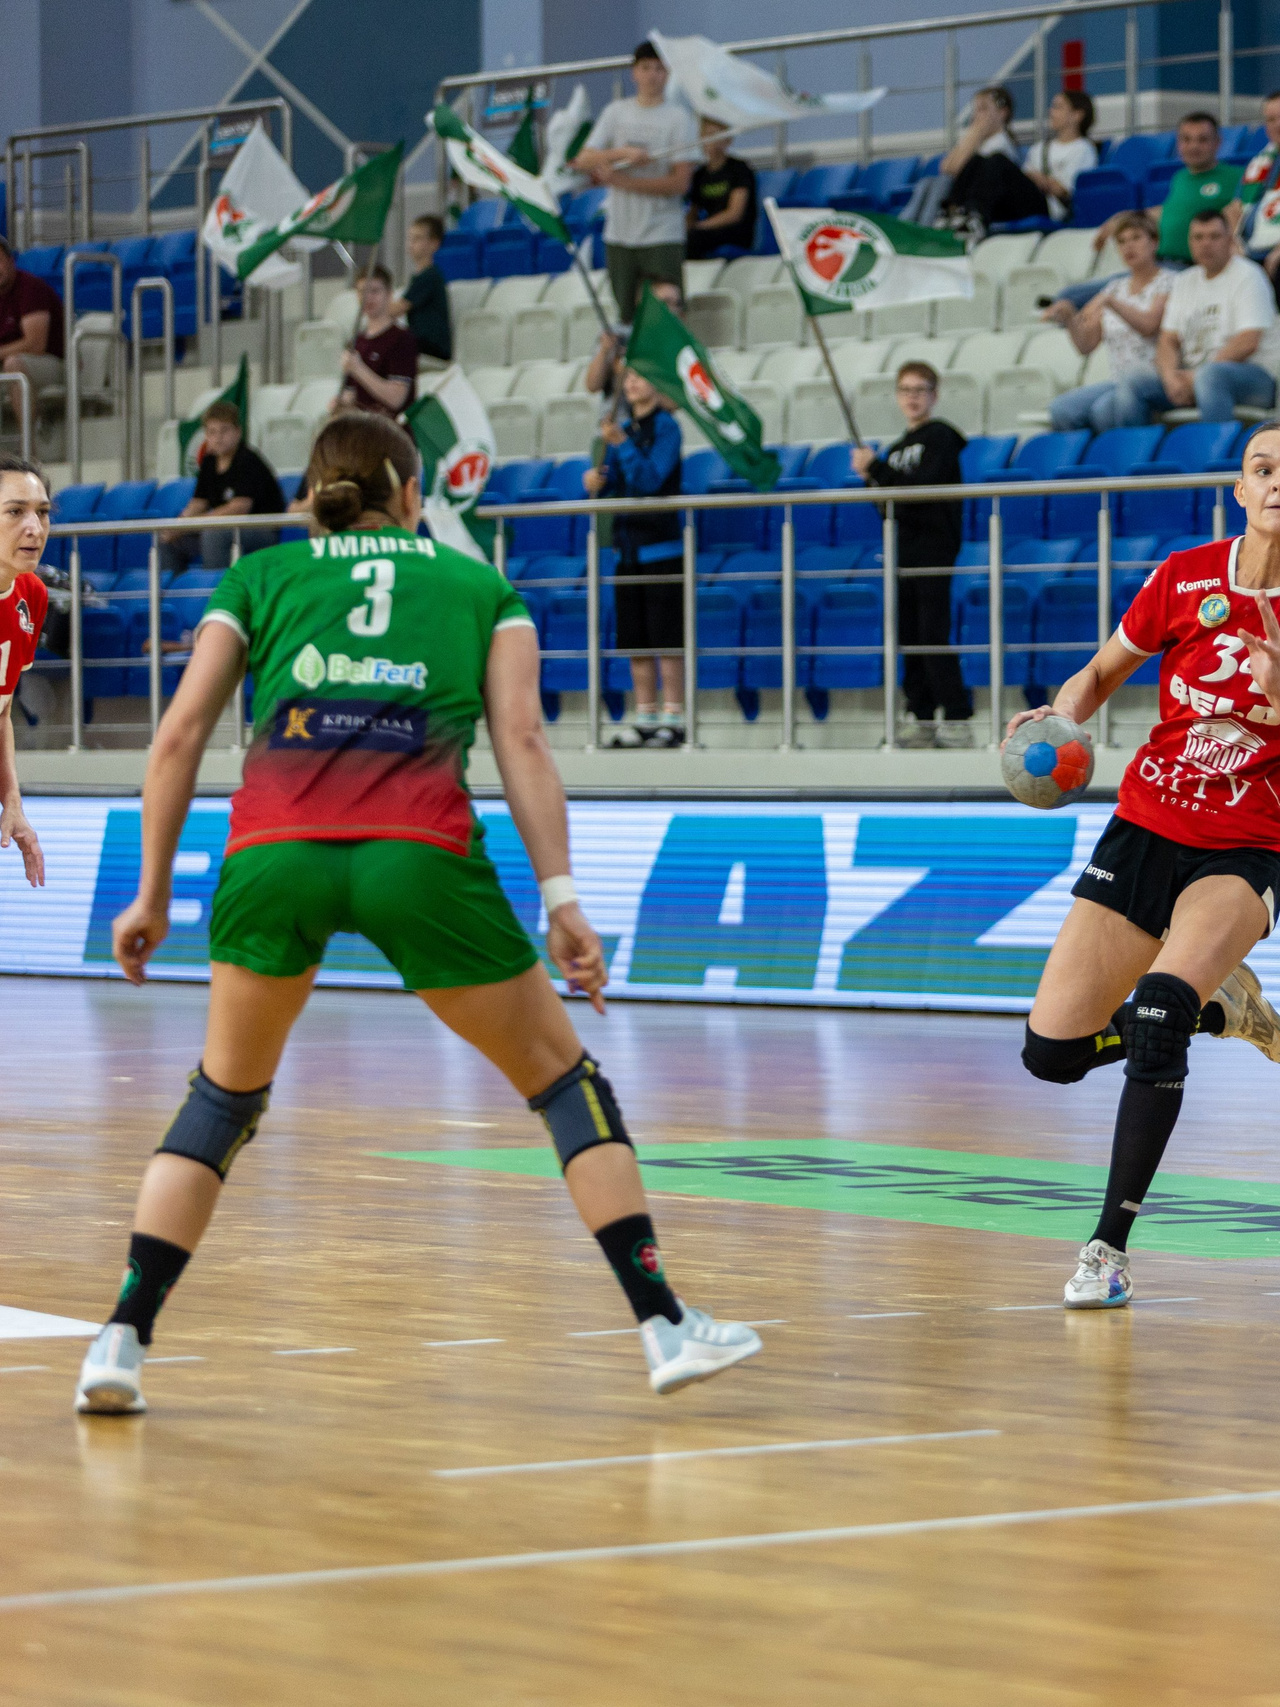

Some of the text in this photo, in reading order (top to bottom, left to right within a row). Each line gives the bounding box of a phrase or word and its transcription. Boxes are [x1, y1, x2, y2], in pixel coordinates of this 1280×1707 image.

[346, 558, 396, 637] 3
[1176, 577, 1222, 594] Kempa
[327, 653, 428, 691] BelFert
[1136, 1006, 1168, 1019] SELECT
